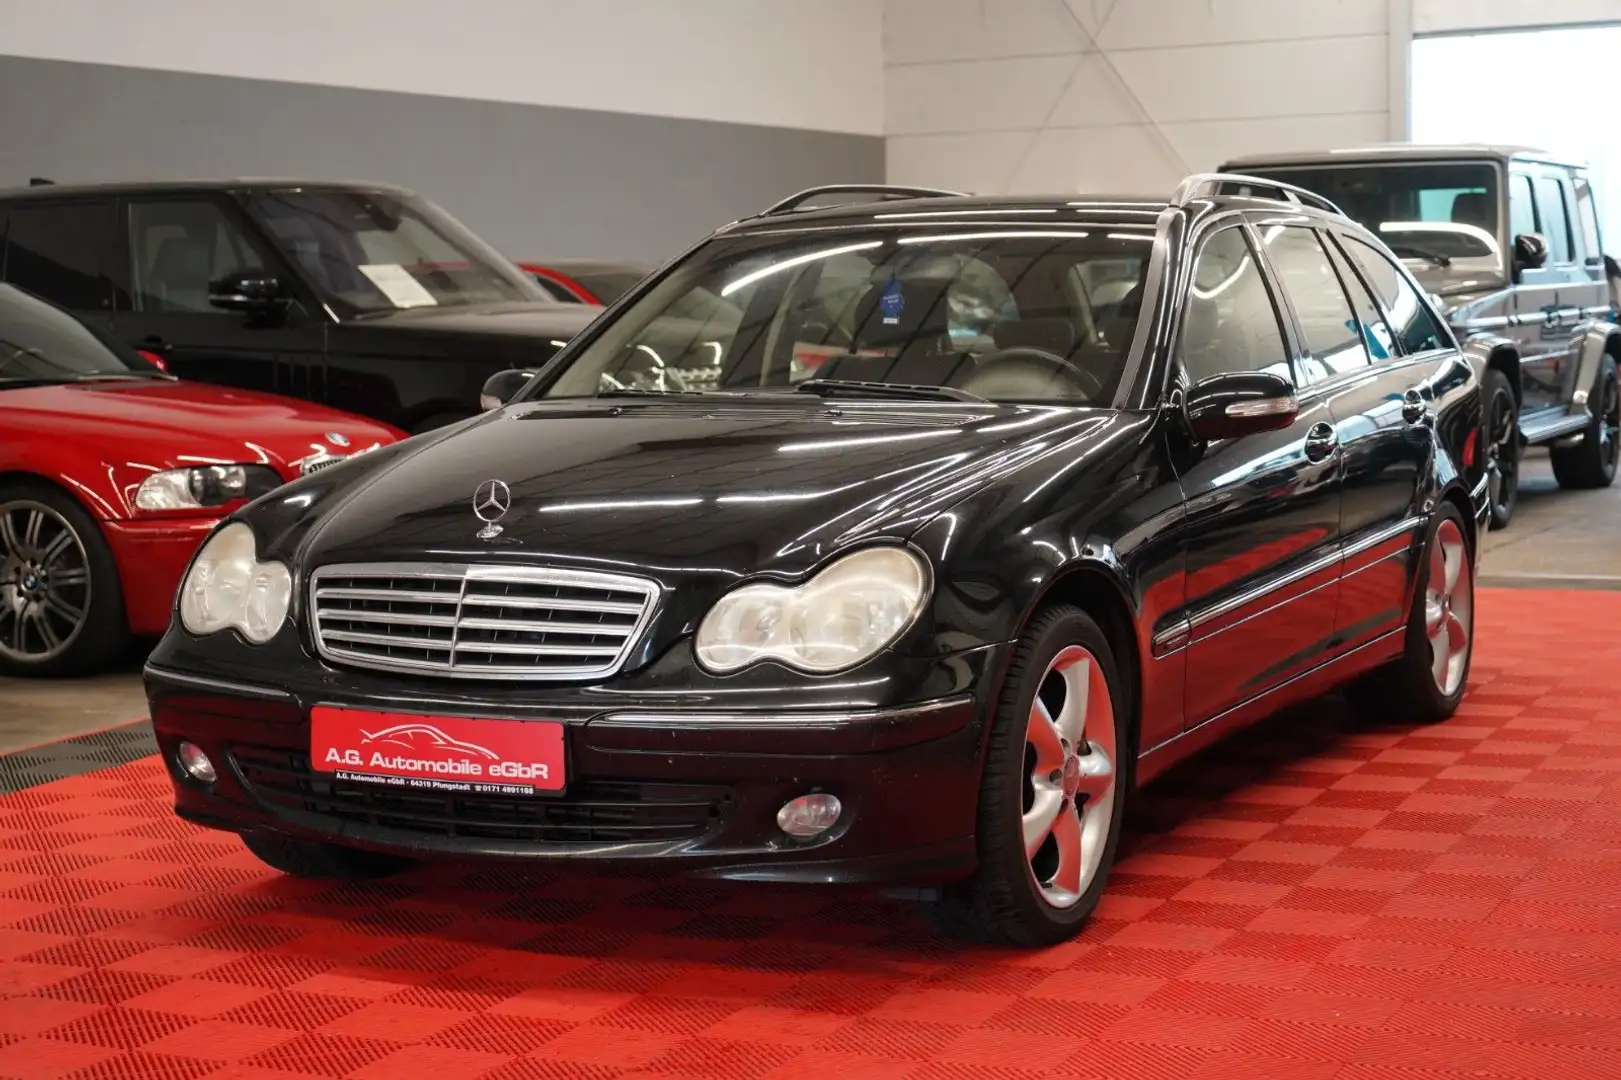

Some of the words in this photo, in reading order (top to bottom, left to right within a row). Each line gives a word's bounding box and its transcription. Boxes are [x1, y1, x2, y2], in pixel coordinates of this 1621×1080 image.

[325, 748, 364, 766] A.G.
[370, 753, 482, 775] Automobile
[489, 761, 548, 779] eGbR
[336, 772, 349, 780] A.G.
[350, 773, 386, 783] Automobile
[410, 779, 431, 787] 64319
